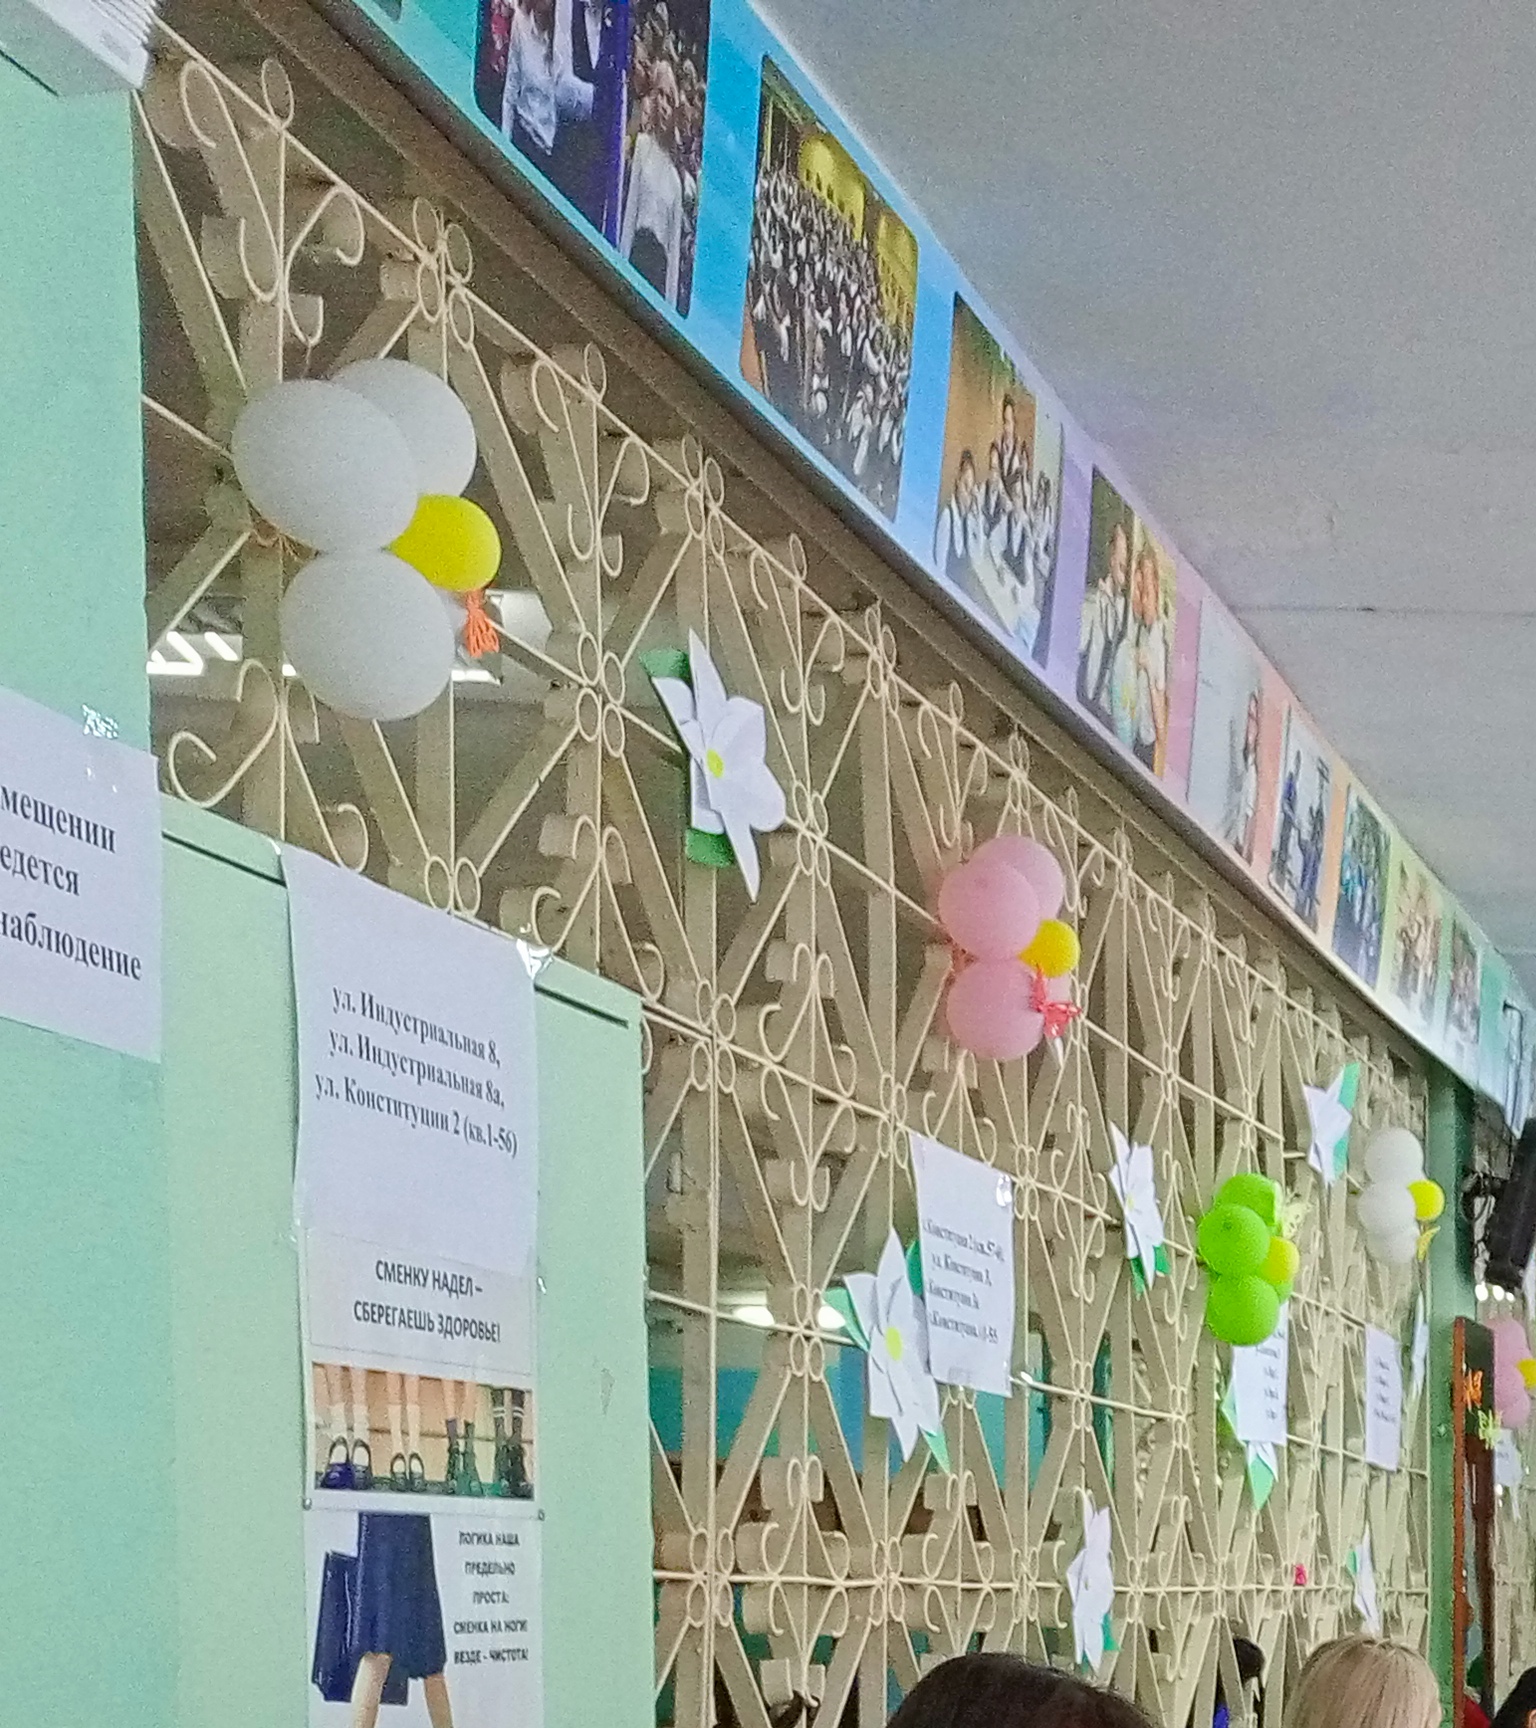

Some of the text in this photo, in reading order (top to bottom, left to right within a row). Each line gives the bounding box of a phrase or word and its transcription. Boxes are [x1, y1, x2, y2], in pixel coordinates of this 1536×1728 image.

[0, 845, 80, 896] едется
[332, 986, 501, 1069] ул. Индустриальная 8,
[328, 1029, 353, 1057] ул.
[357, 1032, 483, 1100] Индустриальная
[315, 1074, 339, 1100] ул.
[344, 1076, 449, 1133] Конституции
[453, 1109, 460, 1136] 2
[375, 1259, 429, 1288] СМЕНКУ
[432, 1269, 473, 1299] НАДЕЛ
[353, 1300, 501, 1343] СБЕРЕГАЕШЬ ЗДОРОВЬЕ!
